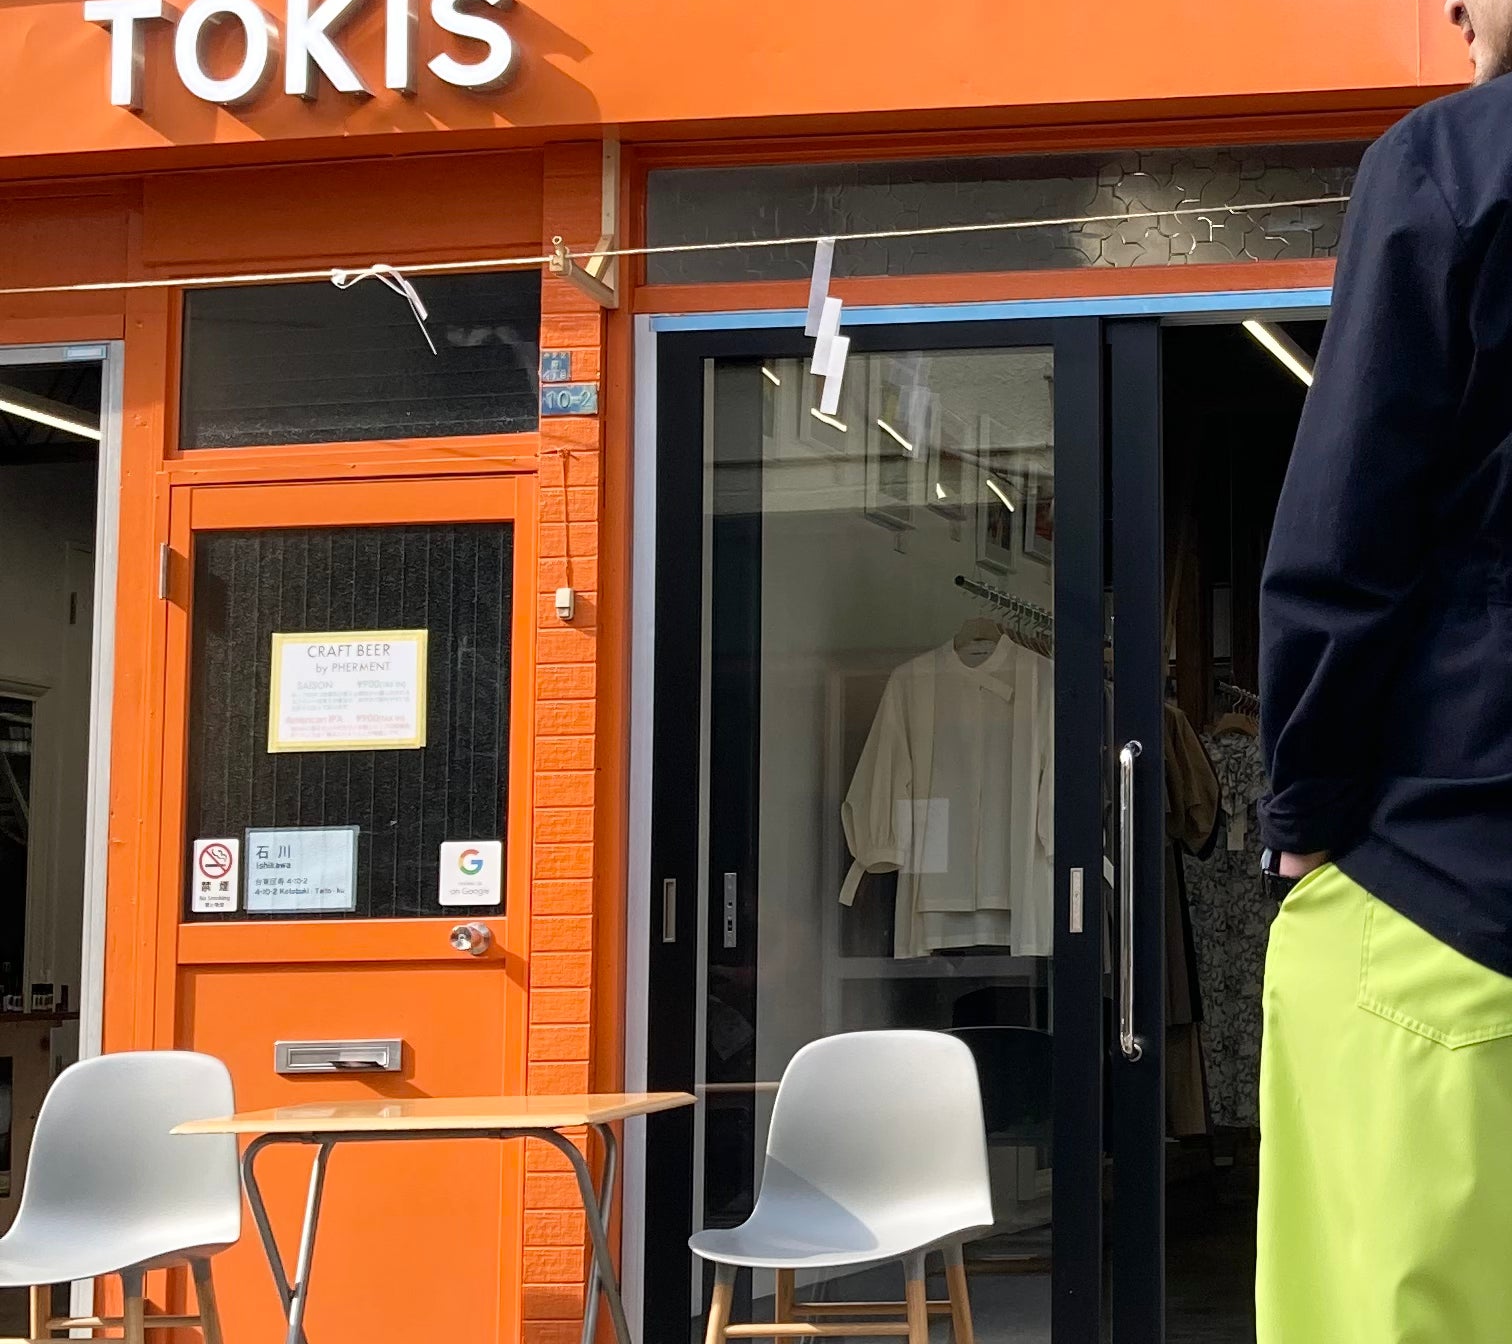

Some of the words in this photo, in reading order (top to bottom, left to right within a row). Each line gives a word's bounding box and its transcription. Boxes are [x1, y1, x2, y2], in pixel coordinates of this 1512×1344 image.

[545, 391, 592, 409] 10-2
[307, 644, 352, 658] CRAFT
[356, 643, 391, 657] BEER
[316, 663, 328, 675] by
[331, 661, 391, 673] PHERMENT
[256, 845, 291, 859] 石川
[462, 887, 489, 896] Google
